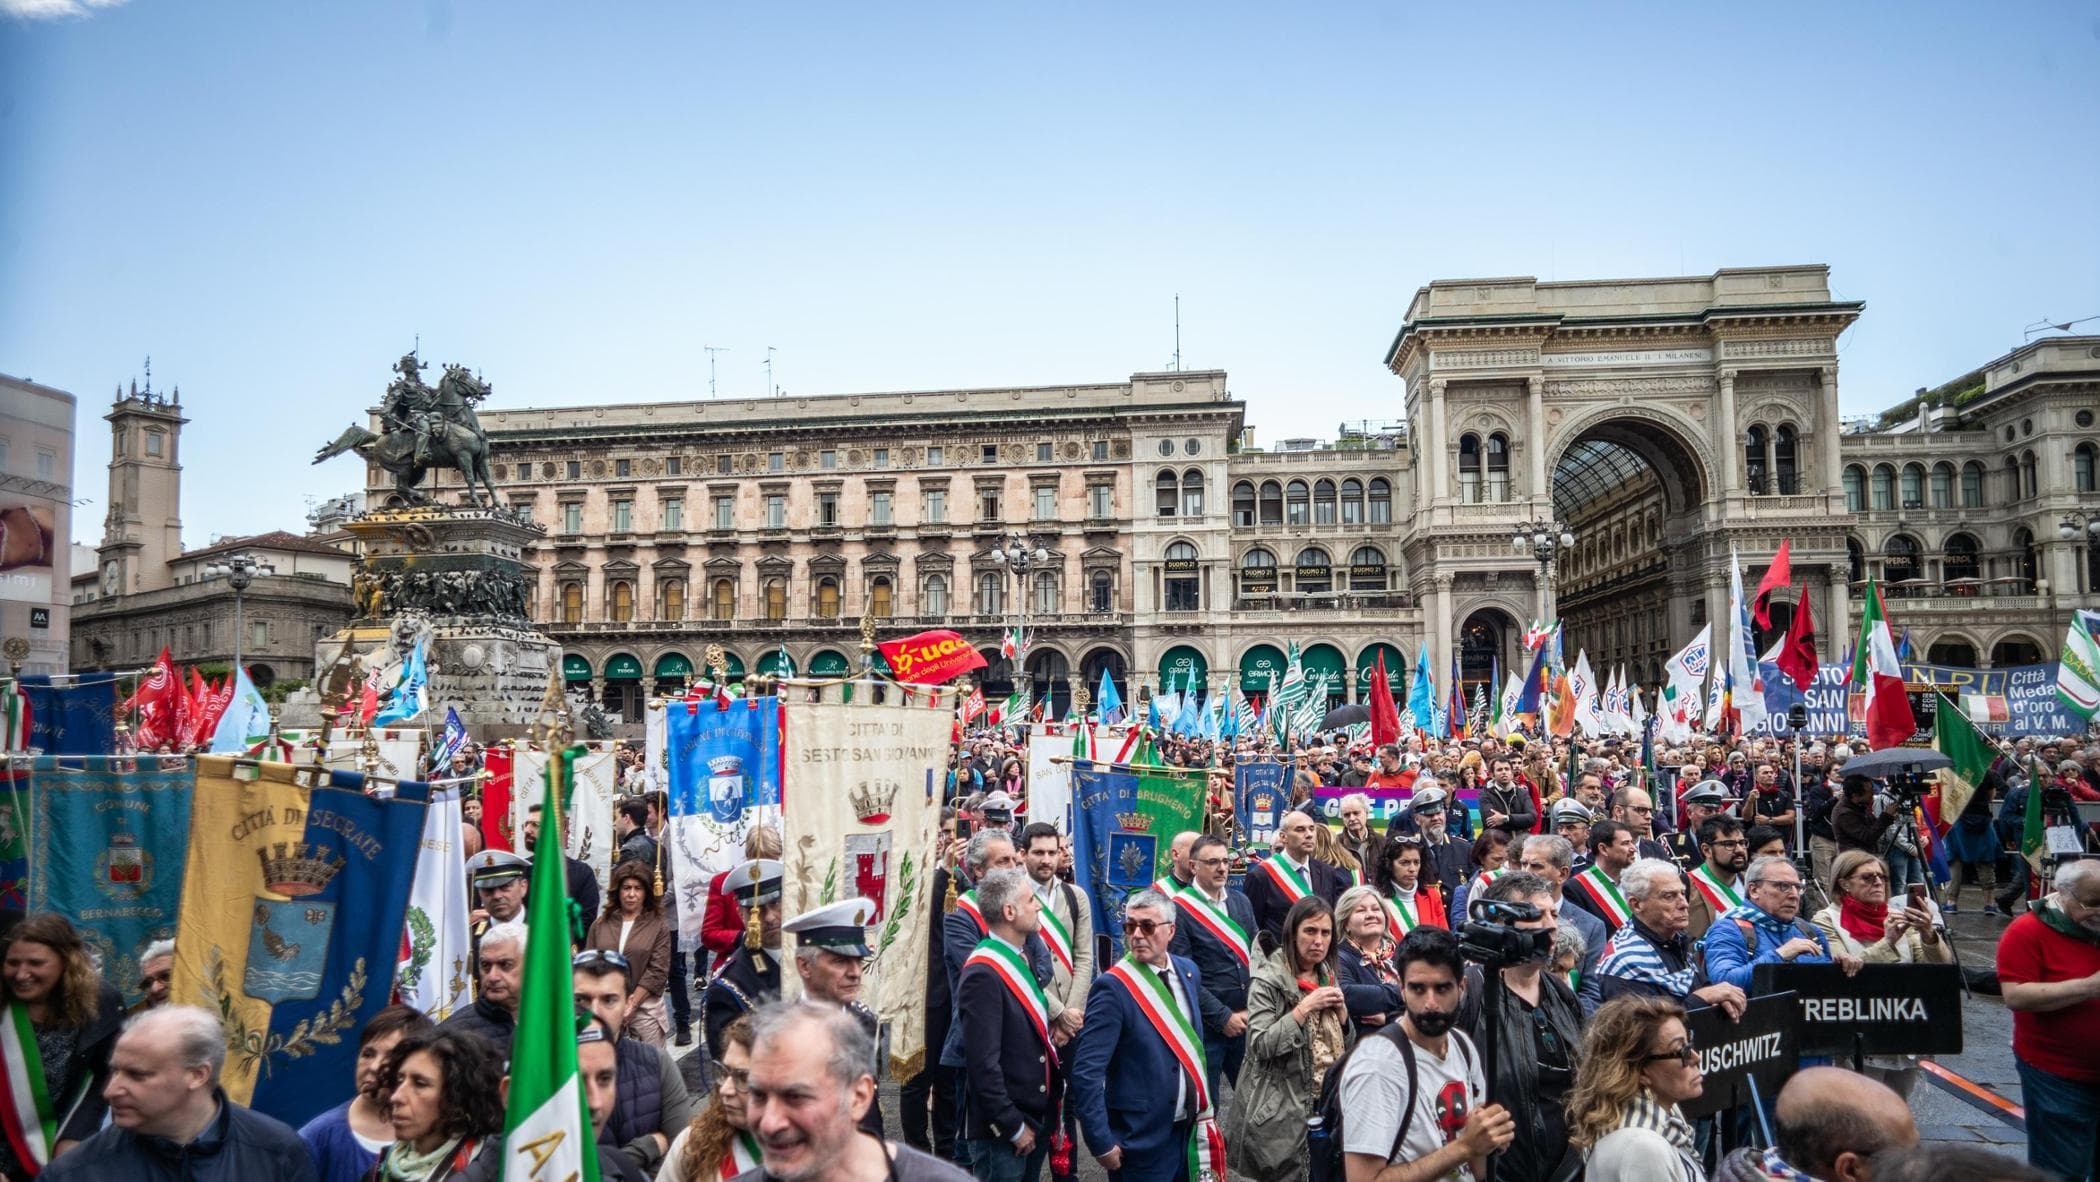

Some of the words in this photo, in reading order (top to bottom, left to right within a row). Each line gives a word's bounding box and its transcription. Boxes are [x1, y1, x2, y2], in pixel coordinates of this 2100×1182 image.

[1558, 355, 1593, 363] VITTORIO
[1597, 353, 1640, 362] EMANUELE
[2010, 669, 2046, 685] Città
[1804, 689, 1845, 708] SAN
[2009, 685, 2057, 699] Meda
[2013, 700, 2055, 714] d'oro
[891, 722, 904, 736] DI
[1755, 713, 1845, 732] GIOANNI
[2015, 717, 2029, 731] al
[2031, 715, 2046, 730] V.
[2052, 715, 2071, 730] M.
[1081, 789, 1111, 810] CITTA'
[1120, 789, 1130, 799] DI
[1137, 790, 1192, 819] BRUGHERIO
[283, 808, 304, 825] DI
[310, 809, 383, 861] SEGRATE
[1800, 998, 1928, 1021] REBLINKA
[1700, 1031, 1781, 1076] USCHWITZ
